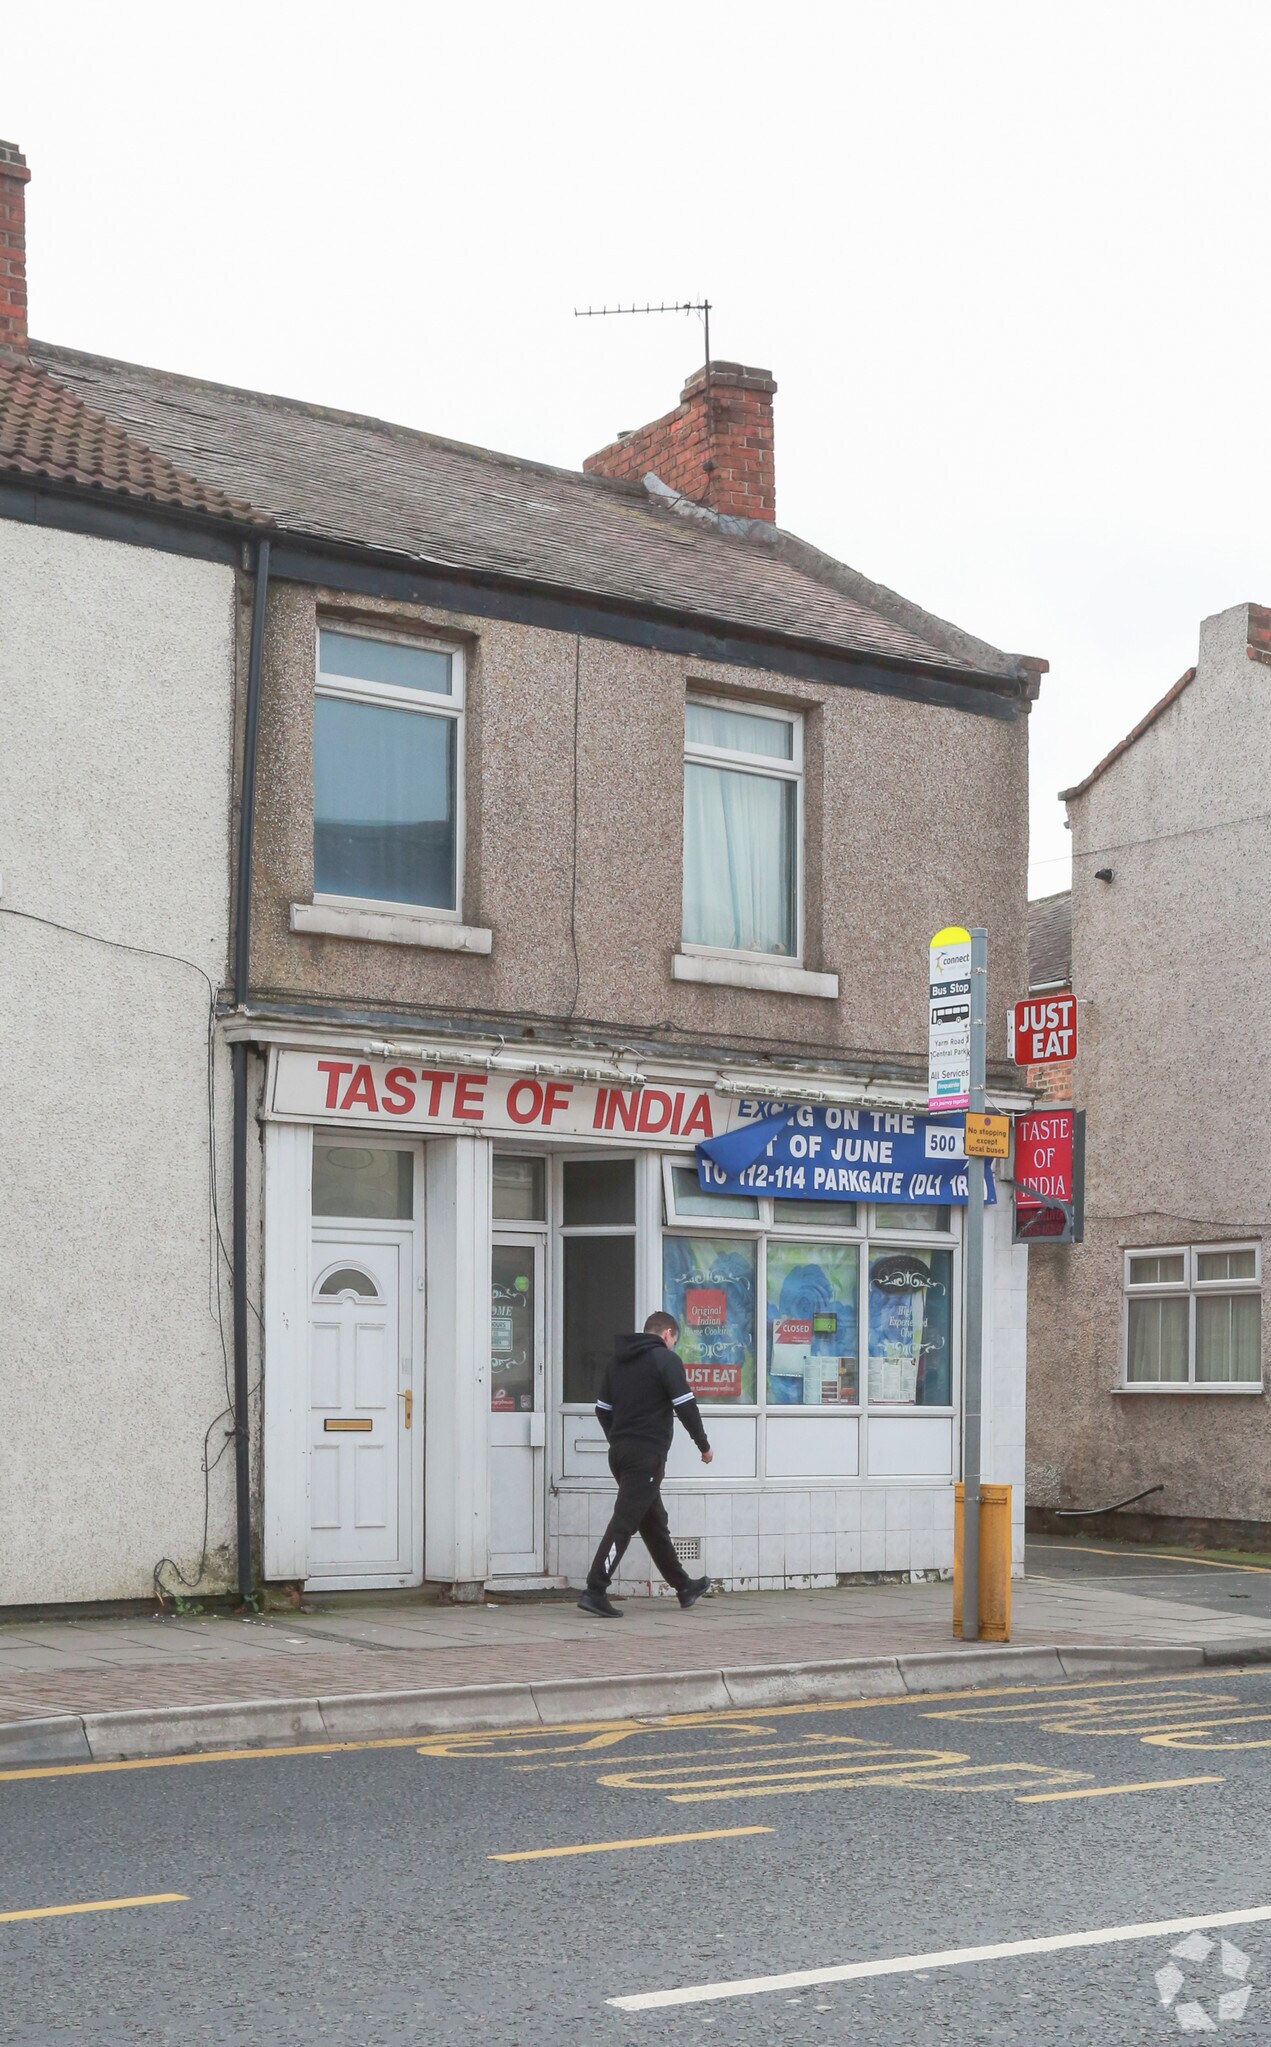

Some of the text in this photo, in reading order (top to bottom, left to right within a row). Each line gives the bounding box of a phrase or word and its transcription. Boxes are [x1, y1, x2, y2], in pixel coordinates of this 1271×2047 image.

[943, 954, 970, 965] connect
[932, 983, 969, 996] Bus Stop
[1019, 1001, 1073, 1032] JUST
[951, 1037, 965, 1045] Road
[1032, 1029, 1073, 1059] EAT
[933, 1050, 953, 1058] Central
[931, 1069, 969, 1080] All Services
[317, 1061, 714, 1138] TASTE OF INDIA
[825, 1107, 859, 1130] ON
[870, 1111, 915, 1134] THE
[979, 1128, 1007, 1138] stopping
[1021, 1119, 1069, 1141] TASTE
[789, 1134, 822, 1158] OF
[831, 1138, 893, 1163] JUNE
[930, 1134, 956, 1152] 500
[976, 1138, 998, 1146] except
[969, 1145, 1005, 1154] local buses
[1034, 1147, 1056, 1168] OF
[739, 1164, 806, 1190] 112-114
[813, 1167, 904, 1195] PARKGATE
[909, 1173, 942, 1199] (DL1
[1022, 1176, 1066, 1197] INDIA
[691, 1305, 722, 1316] Original
[697, 1316, 721, 1326] Indian
[782, 1325, 809, 1333] CLOSED
[713, 1369, 737, 1383] EAT
